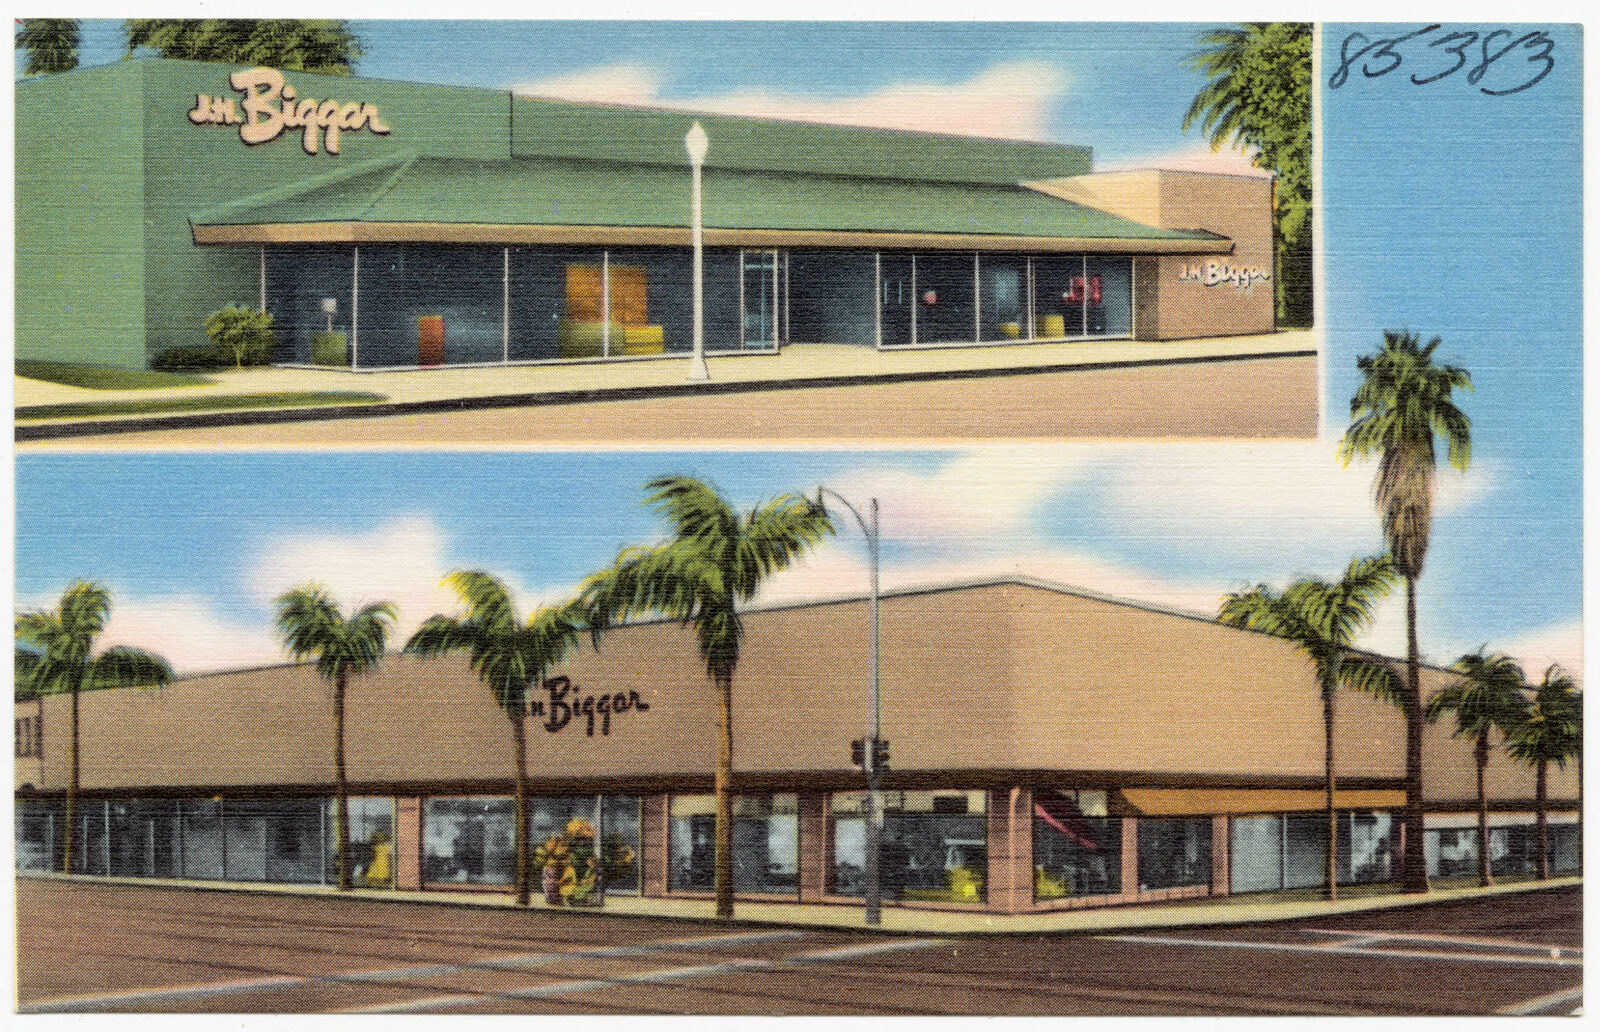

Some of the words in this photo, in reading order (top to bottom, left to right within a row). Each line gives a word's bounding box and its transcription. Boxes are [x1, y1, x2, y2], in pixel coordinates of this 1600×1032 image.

[229, 66, 391, 156] Biggar
[1201, 259, 1270, 290] Biggar
[542, 675, 650, 737] Biggar
